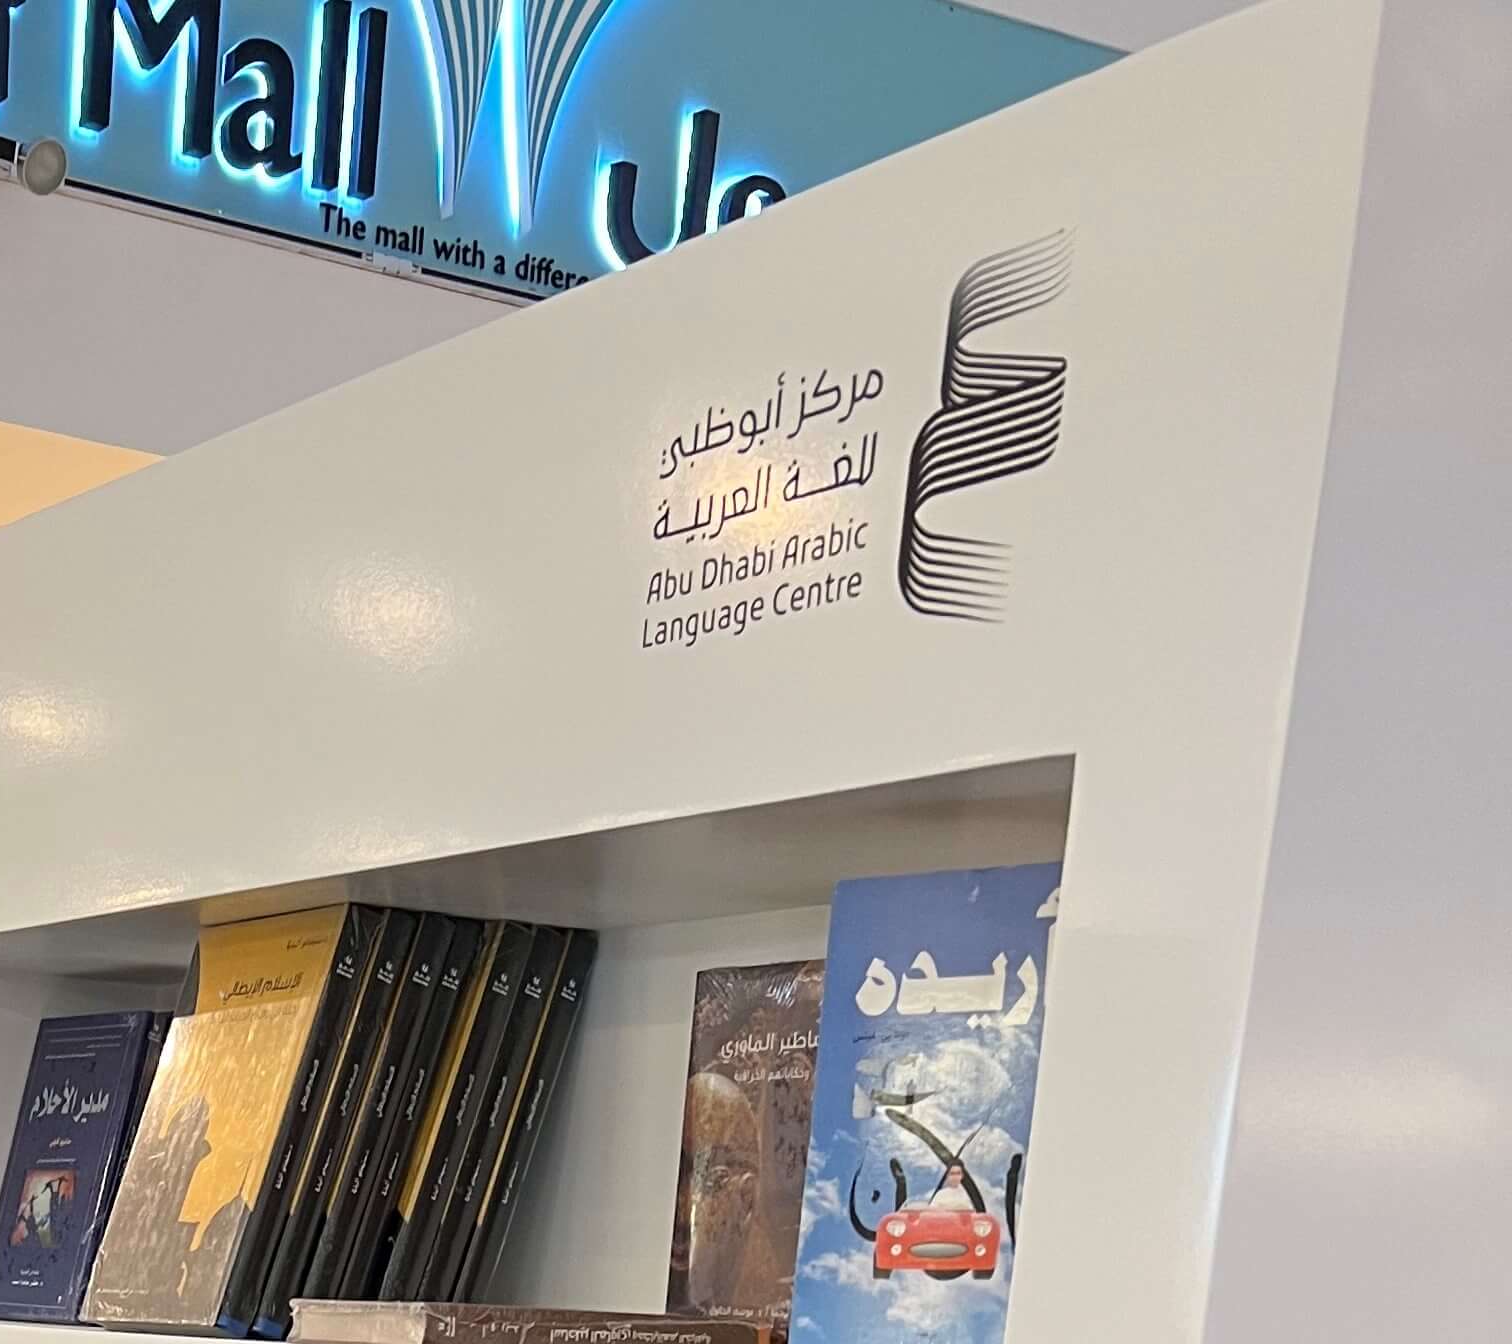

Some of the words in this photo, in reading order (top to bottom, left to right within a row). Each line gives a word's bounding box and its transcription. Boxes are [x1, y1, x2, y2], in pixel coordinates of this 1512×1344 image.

[79, 0, 389, 201] Mall
[318, 203, 366, 240] The
[375, 218, 425, 257] mall
[434, 238, 486, 270] with
[493, 256, 507, 275] a
[659, 370, 786, 479] أبوظبي
[787, 368, 884, 439] مركز
[653, 464, 772, 544] العربية
[782, 432, 878, 502] للغة
[647, 572, 692, 604] Abu
[702, 547, 775, 590] Dhabi
[781, 519, 869, 566] Arabic
[642, 596, 764, 649] Language
[773, 571, 863, 614] Centre
